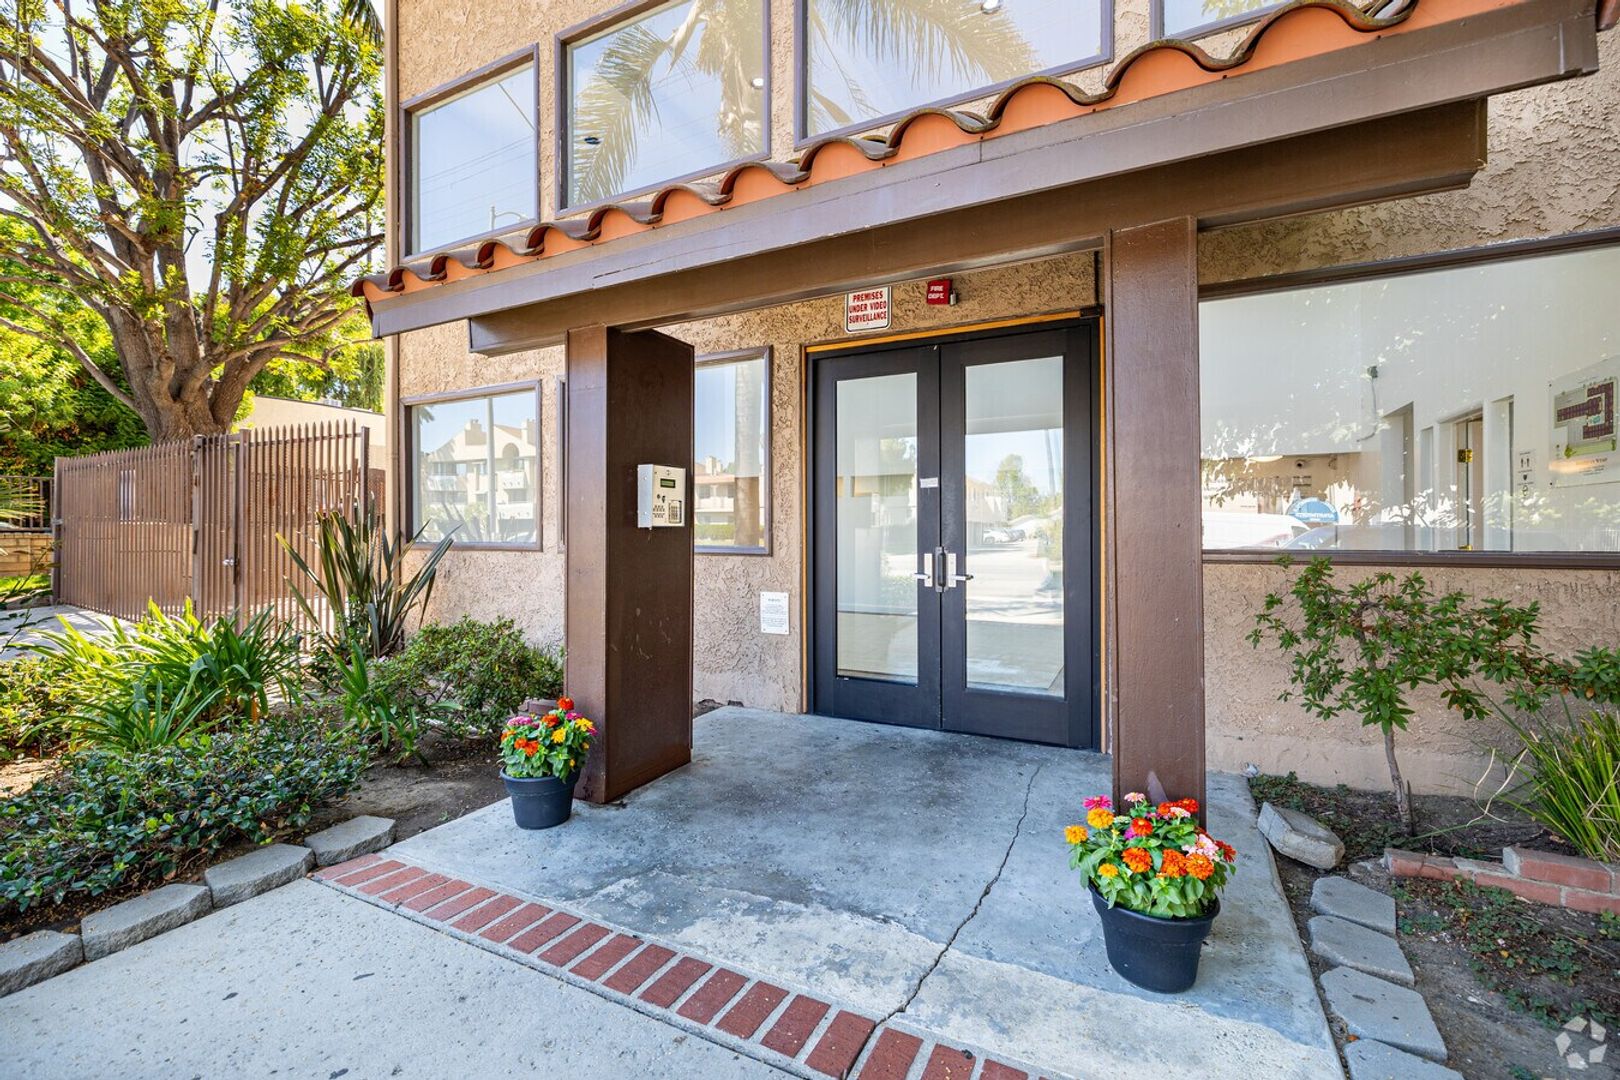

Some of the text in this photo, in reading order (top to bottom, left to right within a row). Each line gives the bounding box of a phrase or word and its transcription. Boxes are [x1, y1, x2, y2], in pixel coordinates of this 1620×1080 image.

[853, 291, 883, 302] PREMISES
[849, 301, 887, 313] UNDER VIDEO
[849, 311, 887, 323] SURVEILLANCE
